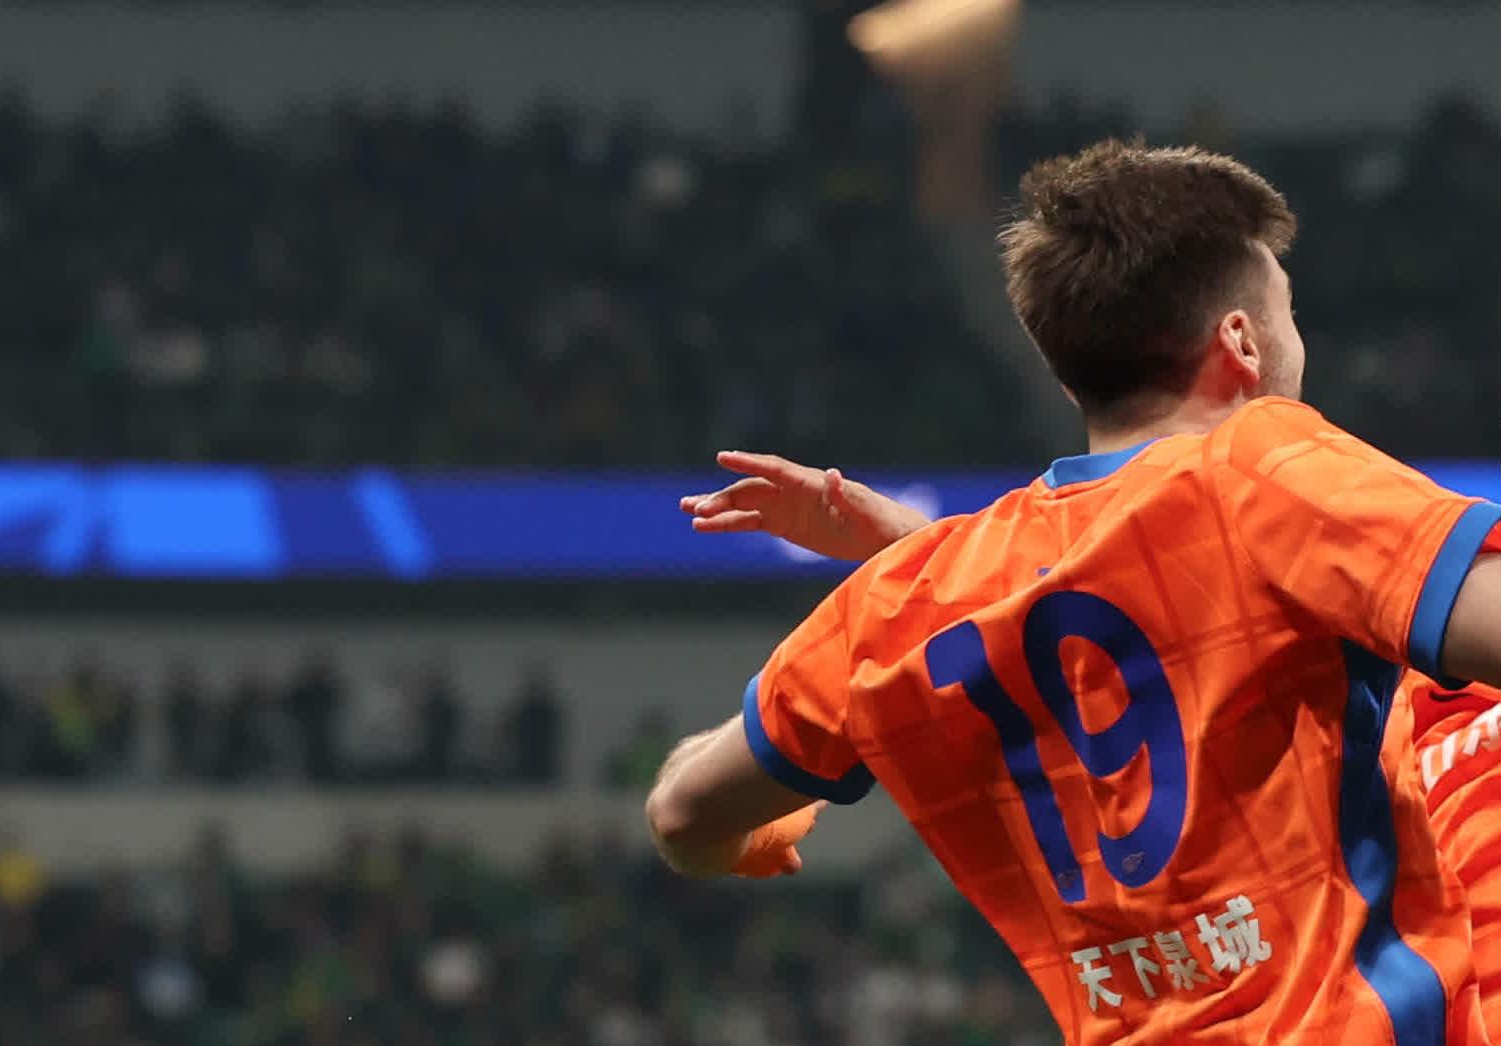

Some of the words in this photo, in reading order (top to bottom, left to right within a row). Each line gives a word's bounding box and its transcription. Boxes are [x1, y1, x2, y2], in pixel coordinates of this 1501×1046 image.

[924, 590, 1189, 904] 19
[1070, 894, 1274, 1013] 天下泉城
